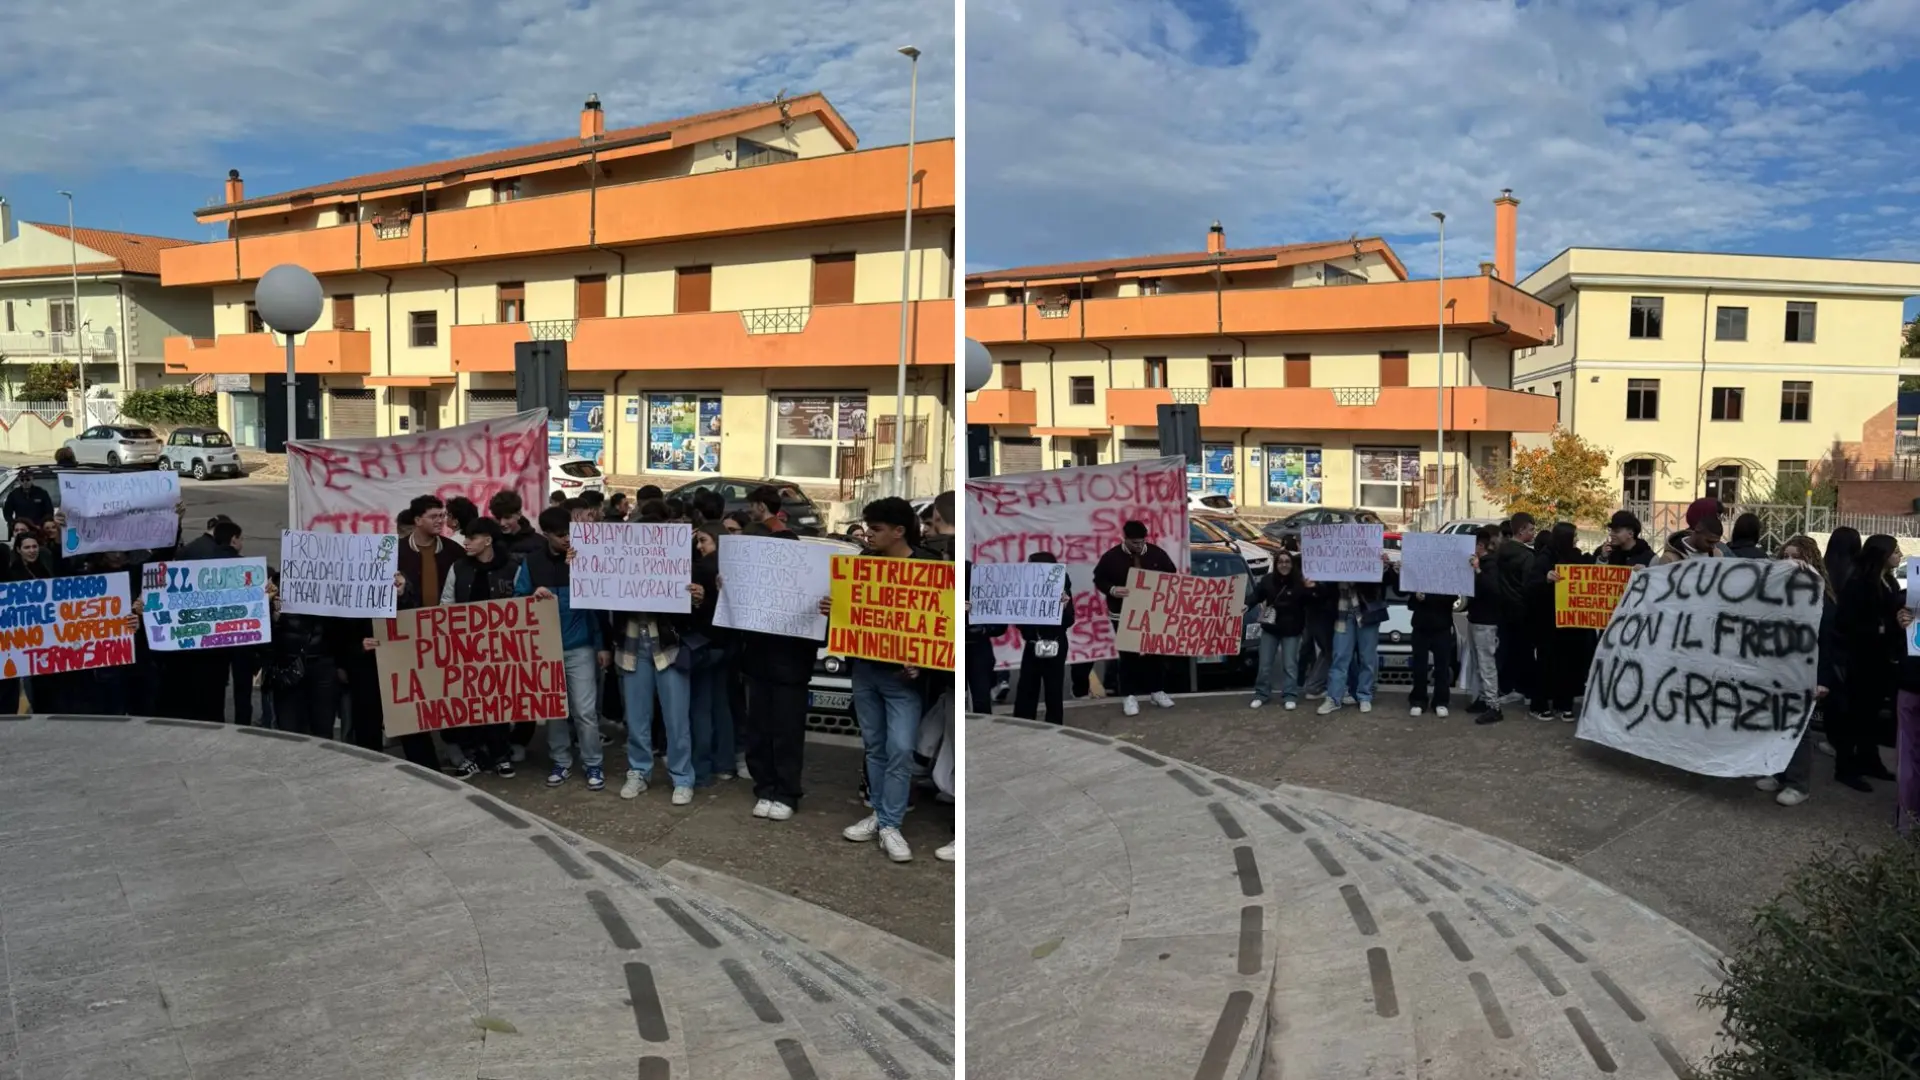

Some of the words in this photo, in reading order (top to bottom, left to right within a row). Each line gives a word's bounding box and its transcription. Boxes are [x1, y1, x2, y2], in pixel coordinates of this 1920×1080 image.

[572, 523, 634, 545] ABBIAMO
[604, 546, 615, 556] DI
[622, 546, 667, 557] STUDIARE
[282, 560, 343, 581] RISCALDACI
[591, 555, 625, 574] QUESTO
[629, 562, 640, 575] LA
[643, 558, 691, 576] PROVINCIA
[52, 576, 107, 601] BABBO
[167, 567, 193, 593] IL
[573, 578, 611, 598] DEVE
[619, 580, 684, 599] LAVORARE
[1136, 571, 1151, 590] IL
[1156, 574, 1227, 596] FREDDO
[1621, 574, 1650, 608] A
[1653, 562, 1819, 606] SCUOLA
[290, 581, 320, 603] MAGARI
[324, 583, 352, 608] ANCHE
[1151, 592, 1233, 617] PUNGENTE
[60, 596, 121, 620] QUESTO
[416, 602, 518, 638] FREDDO
[850, 607, 927, 635] NEGARLA
[1127, 610, 1150, 632] LA
[1163, 614, 1242, 638] PROVINCIA
[1603, 611, 1663, 649] CON
[1671, 611, 1703, 649] IL
[416, 630, 542, 669] PUNGENTE
[1140, 633, 1240, 656] INADEMPIENTE
[391, 669, 425, 704] LA
[443, 660, 566, 698] PROVINCIA
[416, 692, 567, 731] INADEMPIENTE
